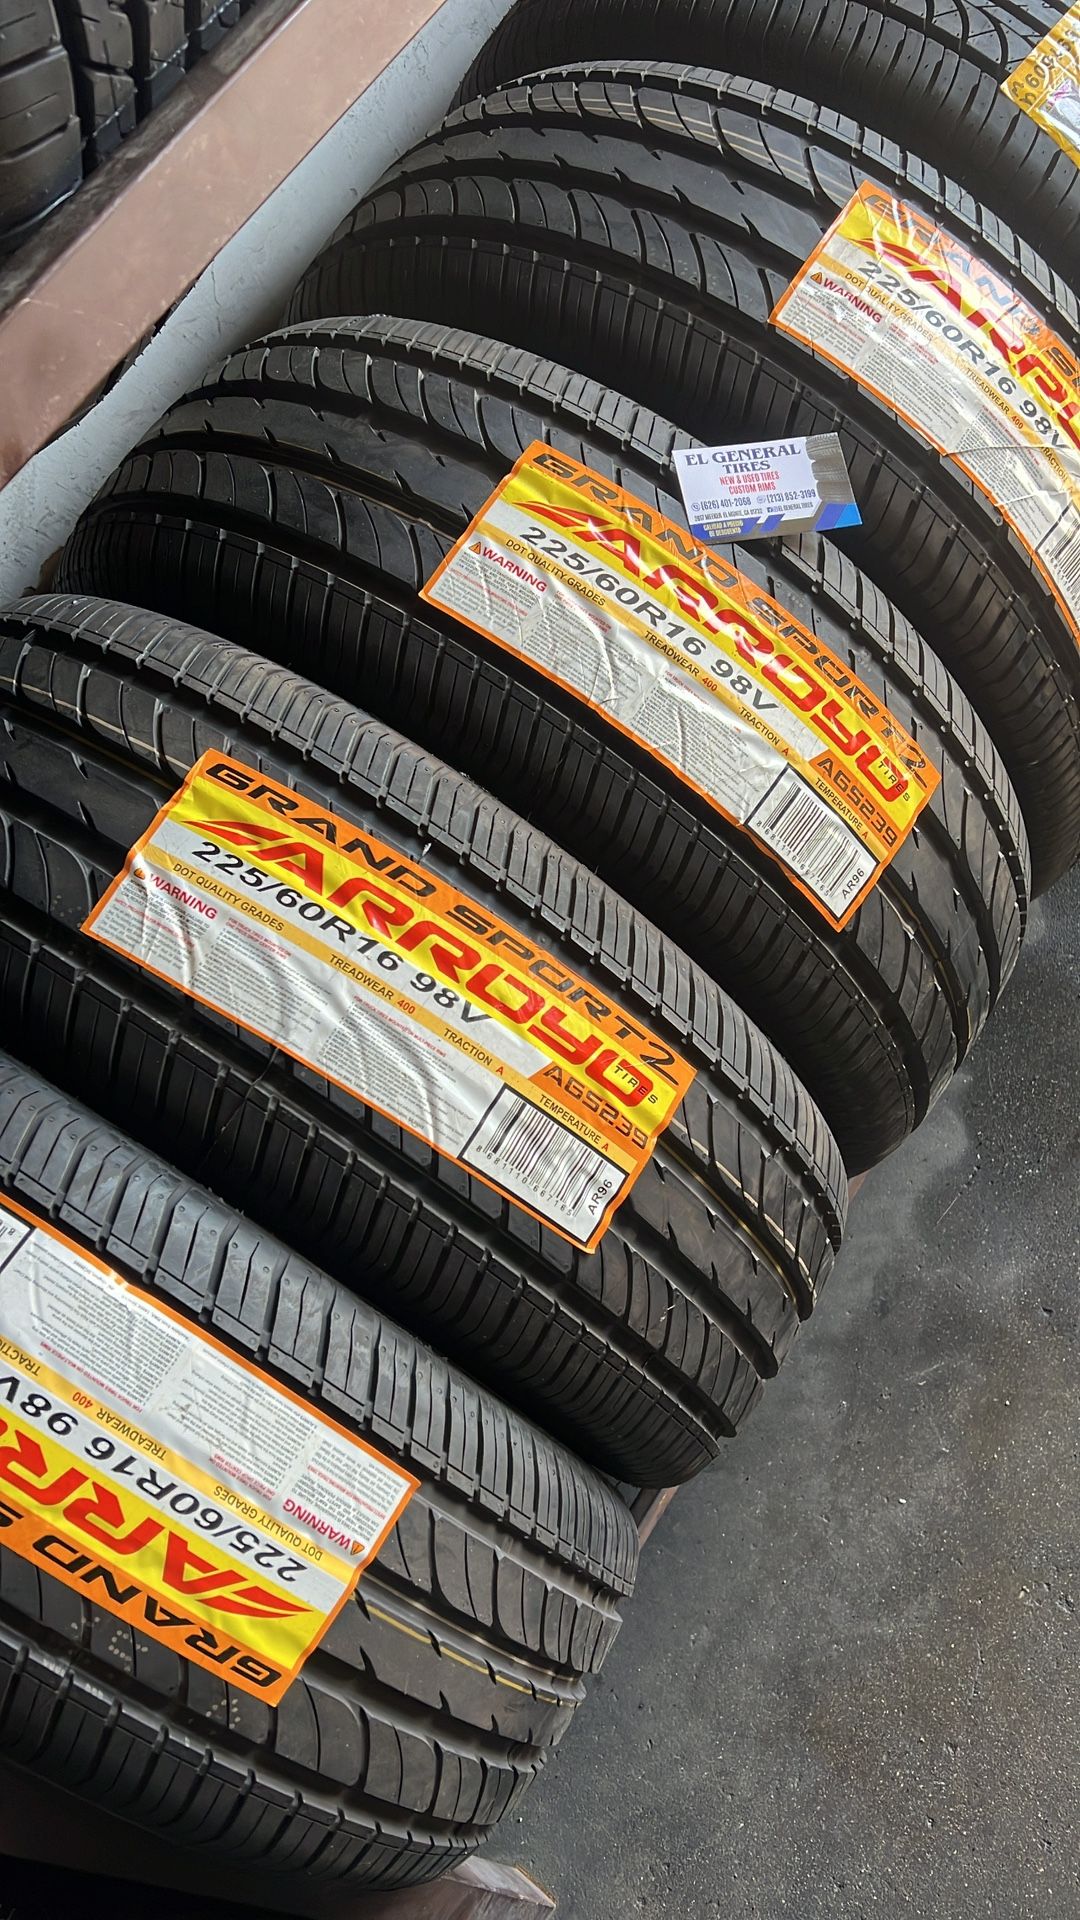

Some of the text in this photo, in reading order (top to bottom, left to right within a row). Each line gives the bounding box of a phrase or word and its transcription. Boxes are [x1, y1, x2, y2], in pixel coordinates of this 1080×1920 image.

[821, 276, 884, 325] WARNING
[844, 271, 864, 288] DOT
[963, 367, 1010, 416] TREADWEAR
[1011, 415, 1024, 430] 400
[1041, 446, 1069, 485] RACTION
[857, 260, 1017, 395] 225/60R16
[1019, 399, 1073, 449] 98V
[685, 444, 801, 466] EL GENERAL
[719, 471, 780, 485] NEW & USED TIRES
[722, 460, 771, 474] TIRES
[700, 499, 720, 511] (626)
[728, 481, 776, 496] CUSTOM RIMS
[766, 489, 817, 504] (213) 852-3199
[532, 452, 739, 589] GRAND
[482, 546, 548, 593] WARNING
[519, 525, 707, 657] 225/60R16
[710, 658, 781, 712] 98V
[511, 501, 910, 802] ARROYO
[505, 538, 870, 840] DOT QUALITY GRADES TREADWEAR 400 TRACTION A TEMPERATURE A
[817, 756, 899, 848] AGS239
[877, 760, 911, 802] TIRES
[205, 762, 437, 898] GRAND
[150, 875, 218, 920] WARNING
[841, 867, 866, 900] AR96
[191, 840, 405, 972] 225/60R16
[410, 971, 493, 1024] 98V
[182, 820, 655, 1108] ARROYO
[172, 863, 609, 1152] DOT QUALITY GRADES TREADWEAR 400 TRACTION A TEMPERATURE A
[542, 1065, 649, 1150] AGS239
[613, 1065, 659, 1105] TIRES
[588, 1178, 614, 1216] AR96
[0, 1376, 79, 1436] 98V
[72, 1391, 94, 1410] 400
[95, 1406, 168, 1462] TREADWEAR
[84, 1436, 308, 1583] 225/60R16
[213, 1485, 258, 1520] GRADES
[283, 1497, 352, 1550] WARNING
[257, 1515, 303, 1548] QUALITY
[301, 1543, 323, 1561] DOT
[32, 1535, 283, 1688] GRAND
